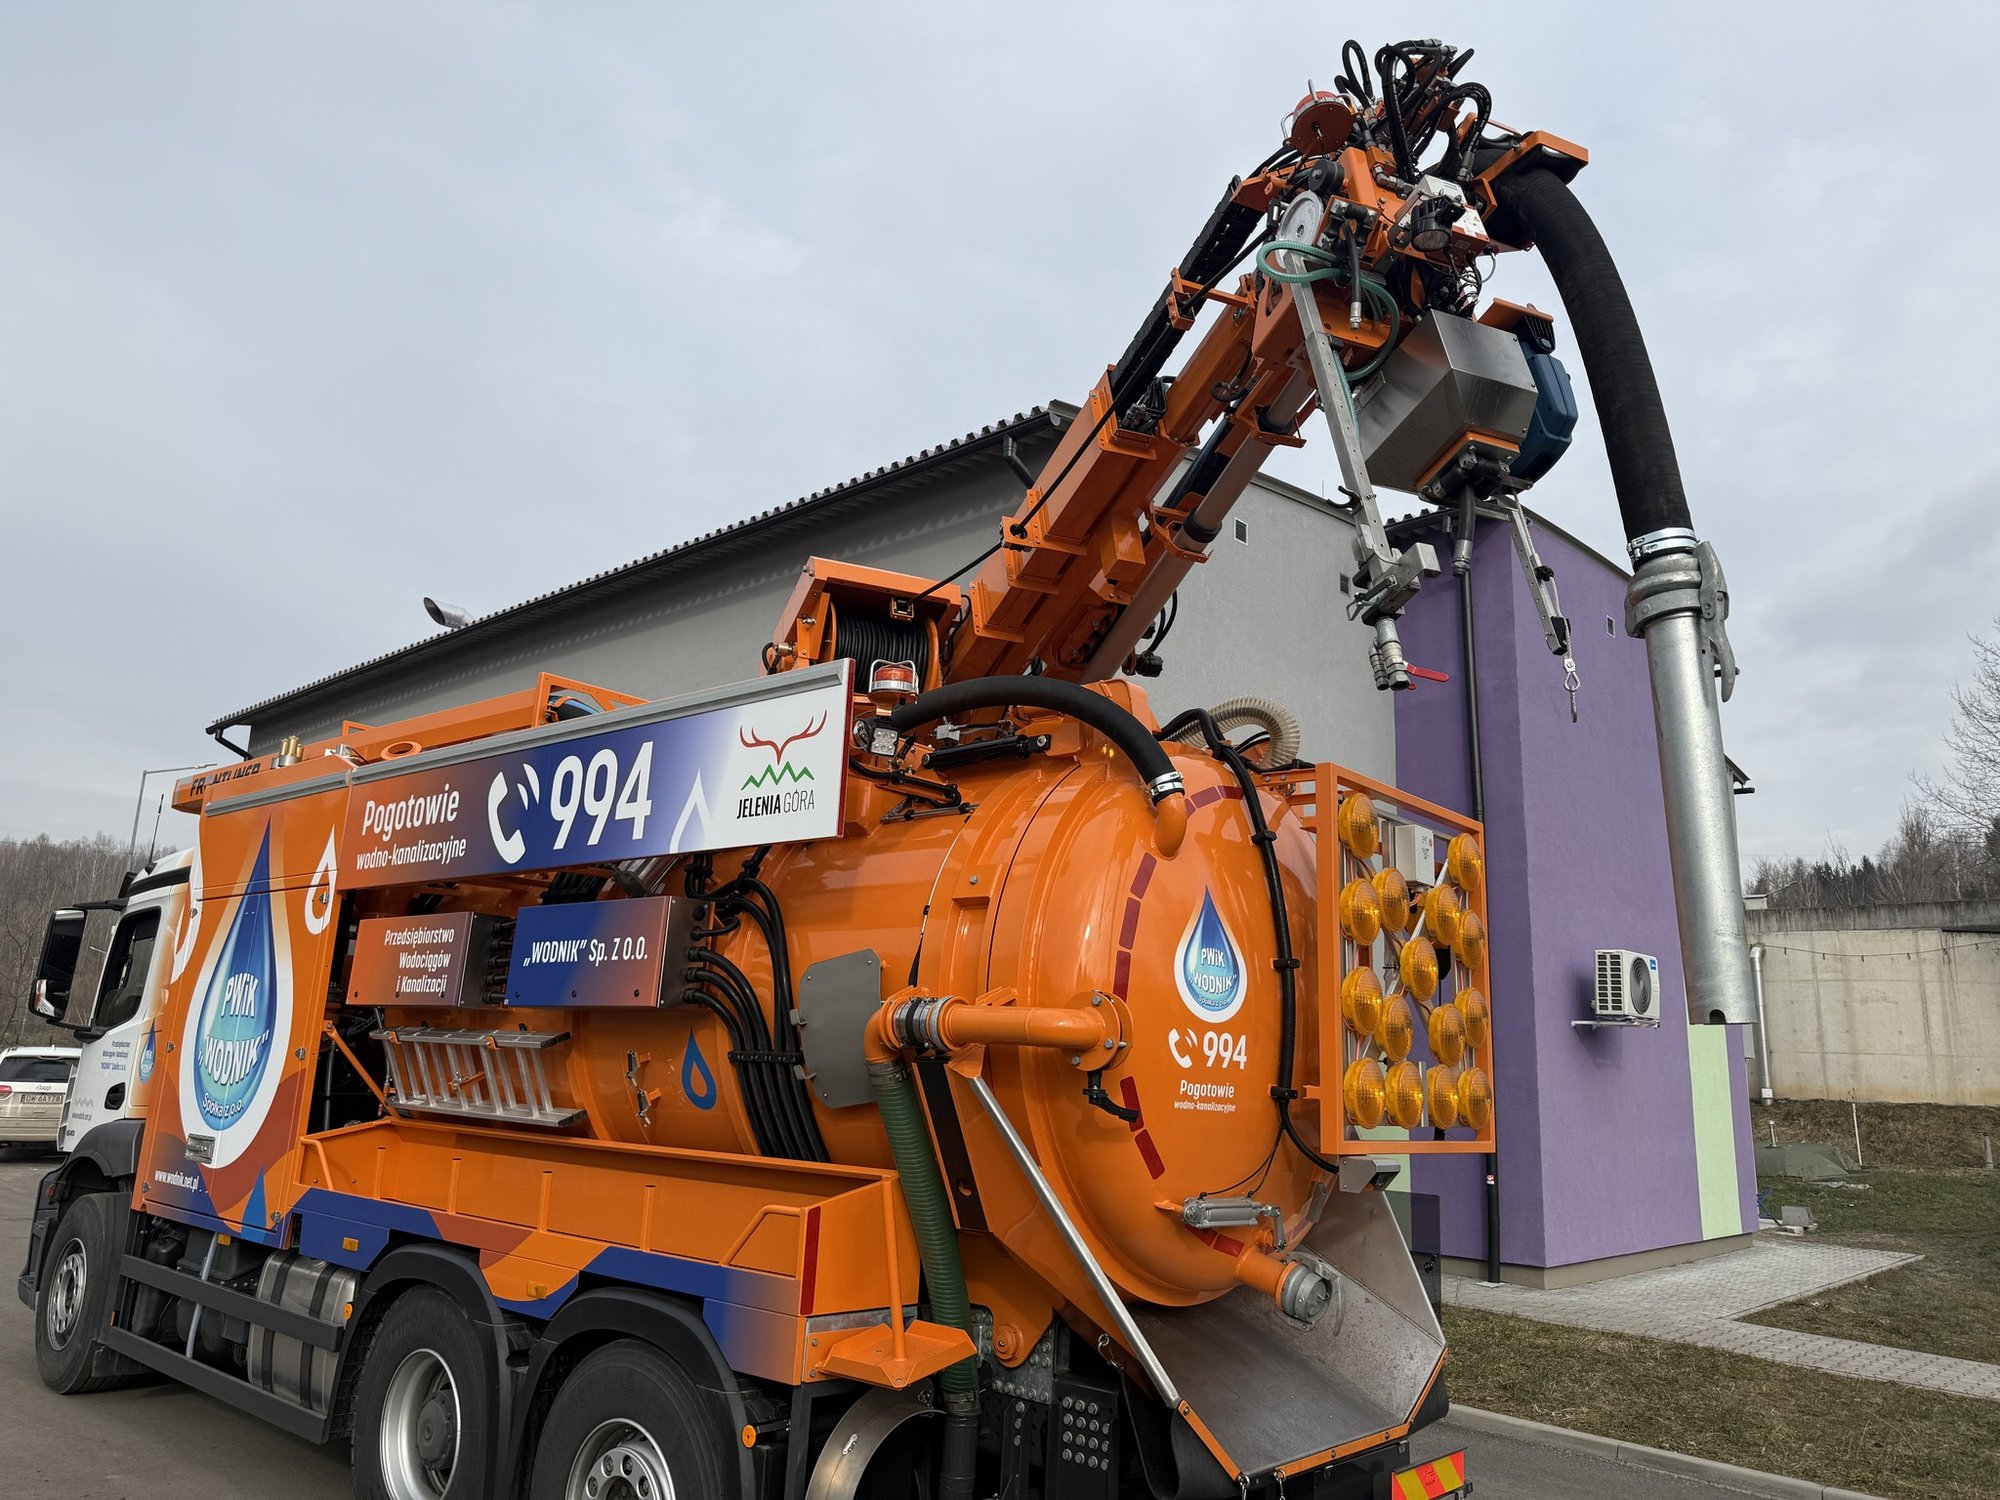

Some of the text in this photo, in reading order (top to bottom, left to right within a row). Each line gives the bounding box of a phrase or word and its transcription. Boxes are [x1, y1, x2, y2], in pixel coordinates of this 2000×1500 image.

[550, 741, 654, 850] 994
[737, 789, 815, 819] JELENIA GÓRA
[362, 783, 461, 841] Pogotowie
[356, 835, 467, 870] wodno-kanalizacyjne
[384, 927, 455, 948] Przedsiębiorstwo
[399, 949, 452, 972] Wodociągów
[588, 938, 608, 967] Sp.
[611, 937, 621, 960] Z
[1201, 947, 1226, 968] PWiK
[221, 972, 259, 1018] PWiK
[396, 974, 448, 997] i Kanalizacji
[1203, 1031, 1247, 1070] 994
[1180, 1080, 1235, 1100] Pogotowie
[202, 1092, 244, 1119] Spółka z o.o.
[1174, 1100, 1236, 1114] wodno-kanalizacyjne
[155, 1170, 200, 1192] www.wodnik.net.pl
